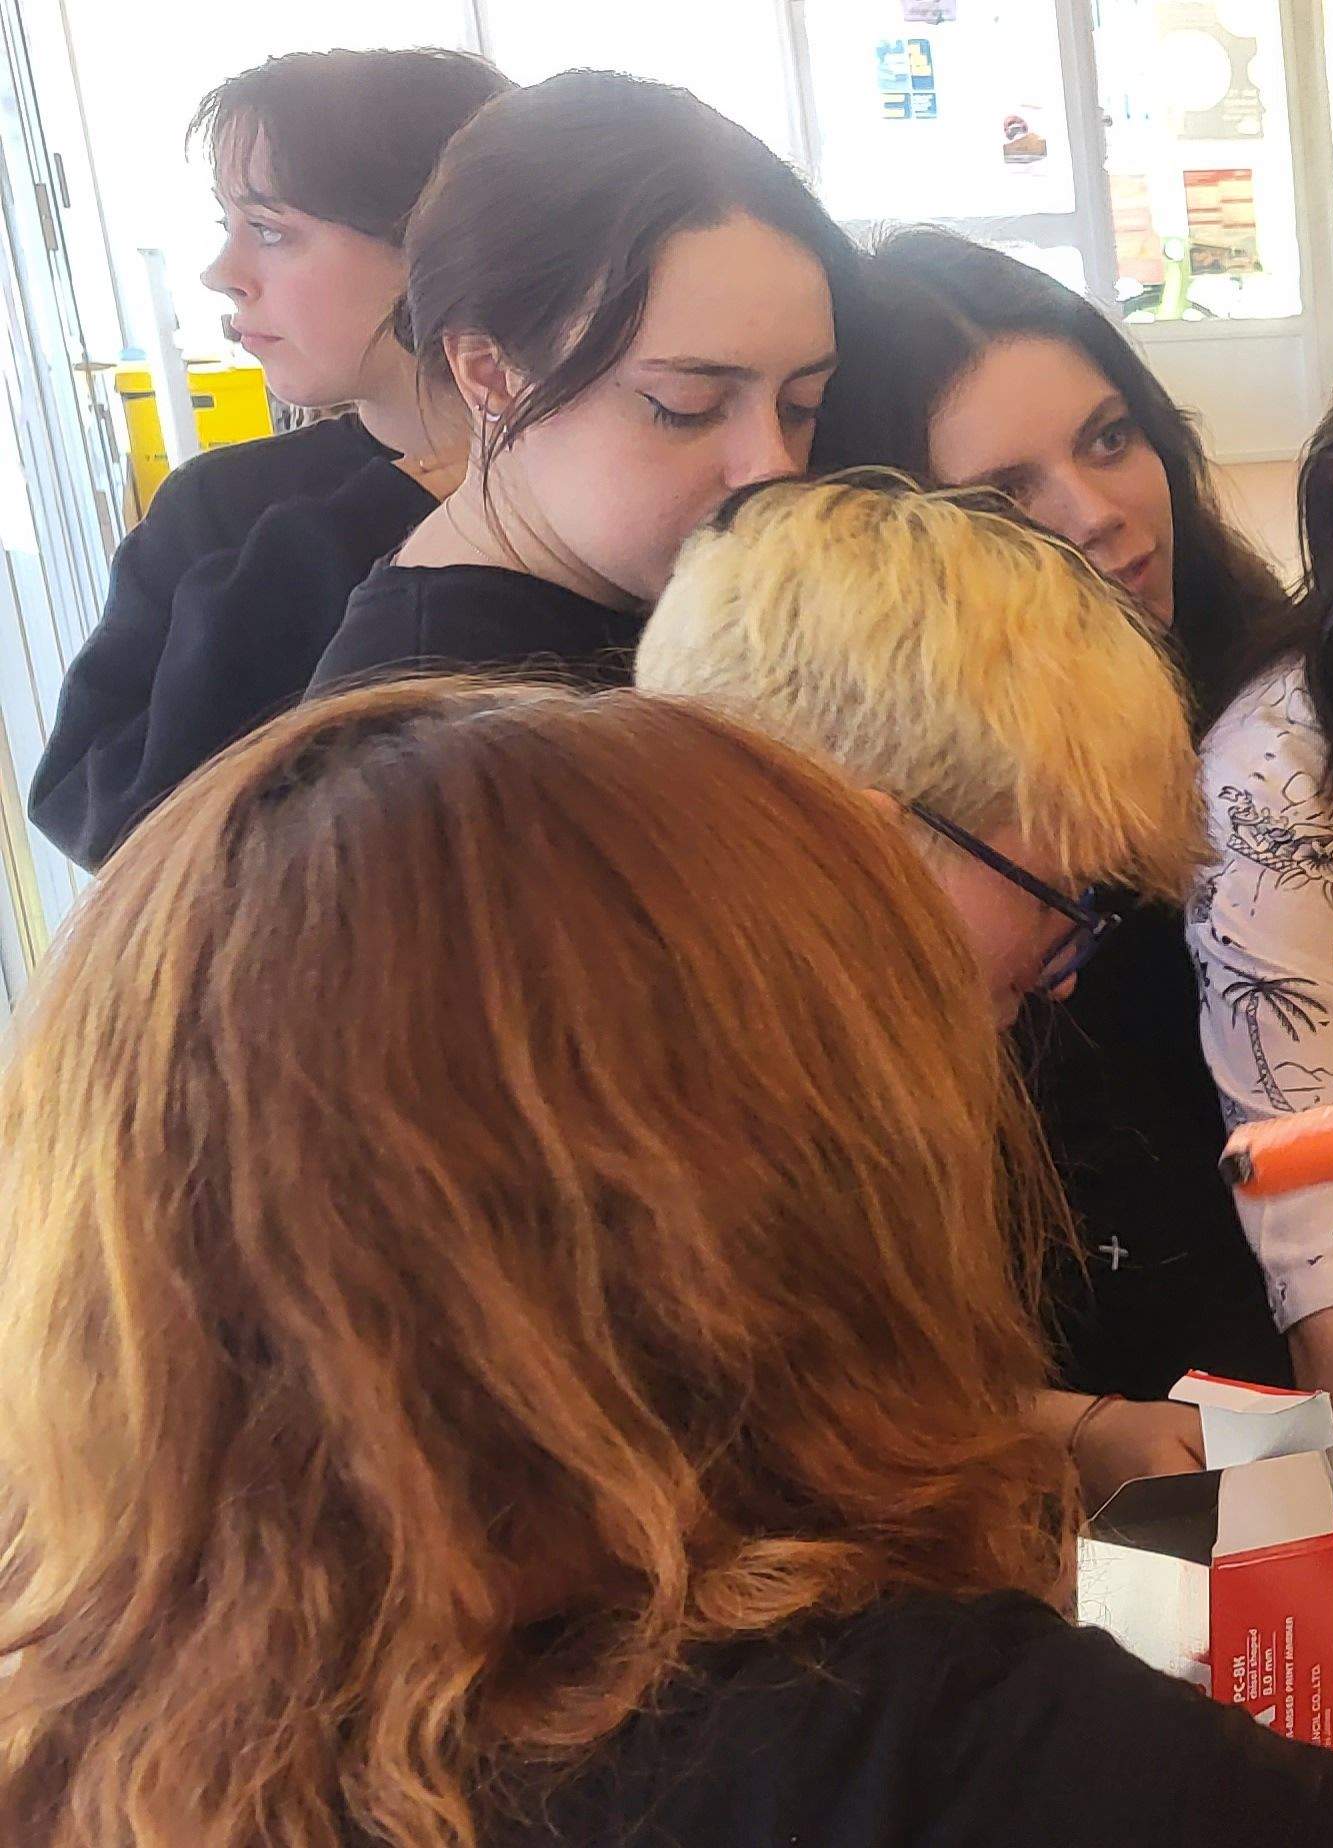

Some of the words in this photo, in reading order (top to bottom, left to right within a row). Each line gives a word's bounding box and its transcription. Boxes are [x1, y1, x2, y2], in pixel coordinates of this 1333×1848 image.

[1249, 1628, 1258, 1667] shaped
[1264, 1648, 1273, 1672] mm
[1233, 1655, 1246, 1703] PC-8K
